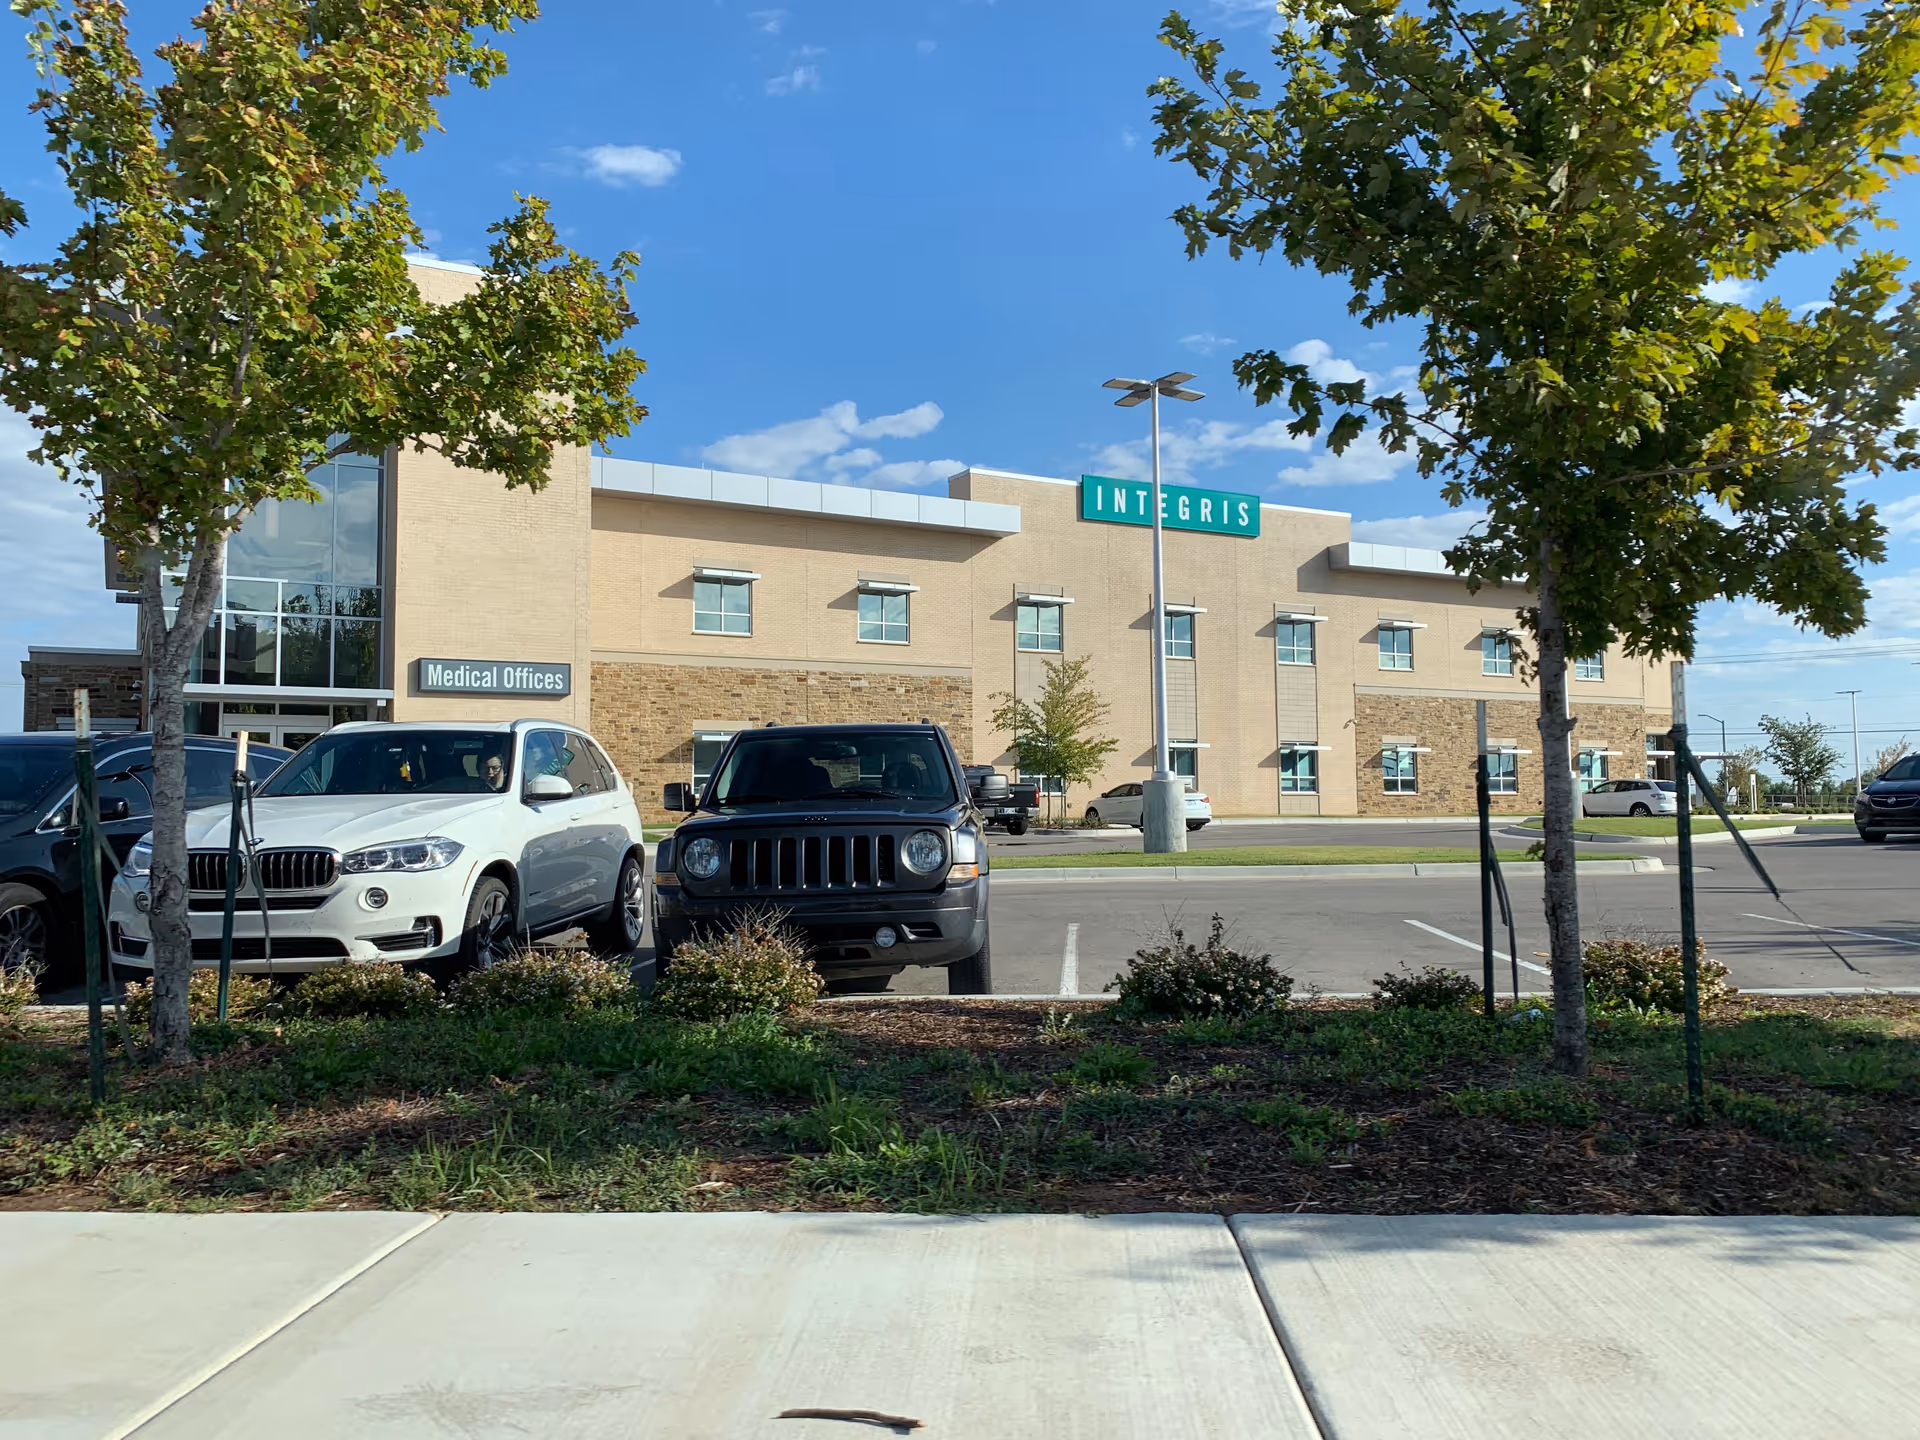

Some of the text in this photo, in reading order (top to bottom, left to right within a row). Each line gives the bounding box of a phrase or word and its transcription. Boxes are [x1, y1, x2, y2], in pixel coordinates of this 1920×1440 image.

[1097, 485, 1249, 527] INTEGRIS
[428, 664, 564, 690] Medical Offices
